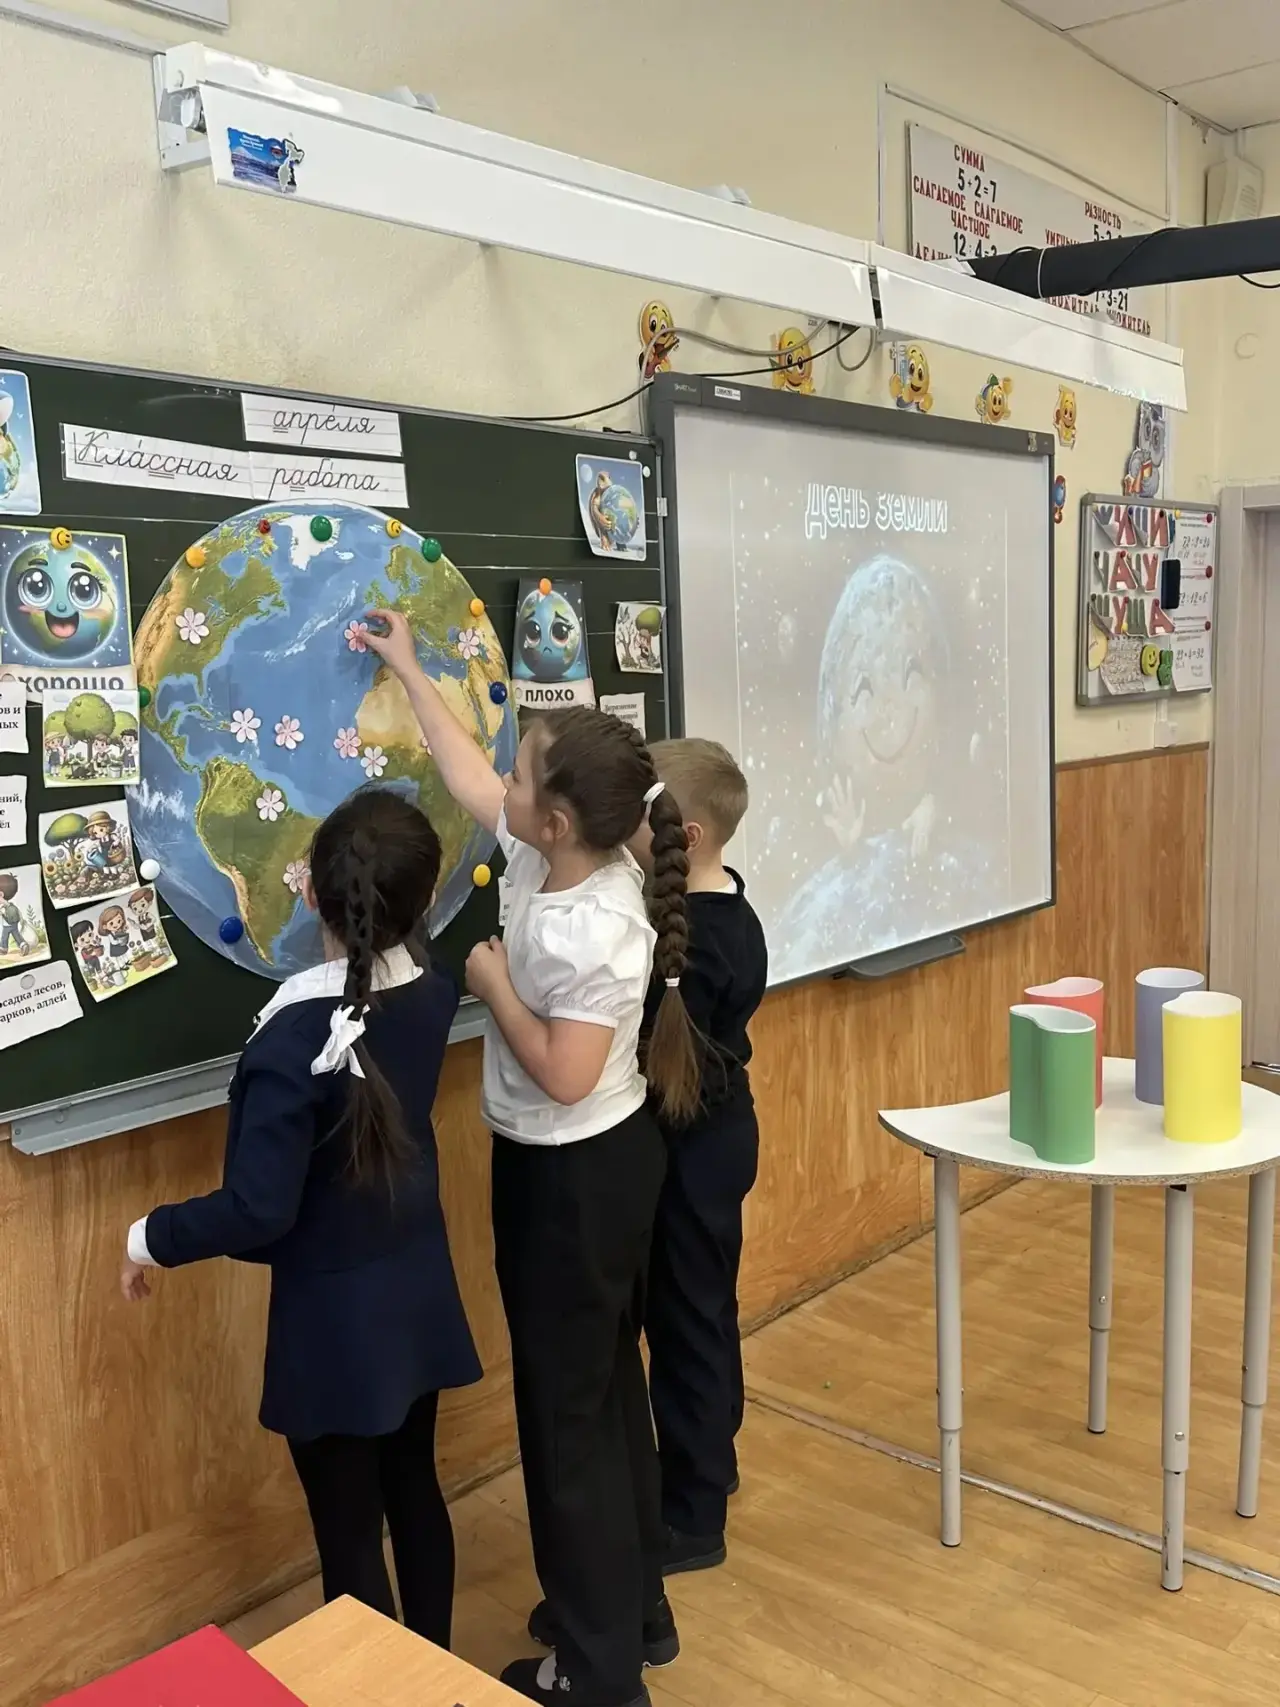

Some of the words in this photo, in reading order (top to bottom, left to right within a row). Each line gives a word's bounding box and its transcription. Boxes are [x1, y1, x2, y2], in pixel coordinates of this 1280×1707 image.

[954, 144, 985, 173] СУММА
[913, 175, 966, 211] СЛАГАЕМОЕ
[974, 200, 1024, 235] СЛАГАЕМОЕ
[1084, 201, 1122, 230] РАЗНОСТЬ
[951, 209, 990, 240] ЧАСТНОЕ
[33, 980, 66, 997] лесов,
[36, 991, 68, 1010] аллей
